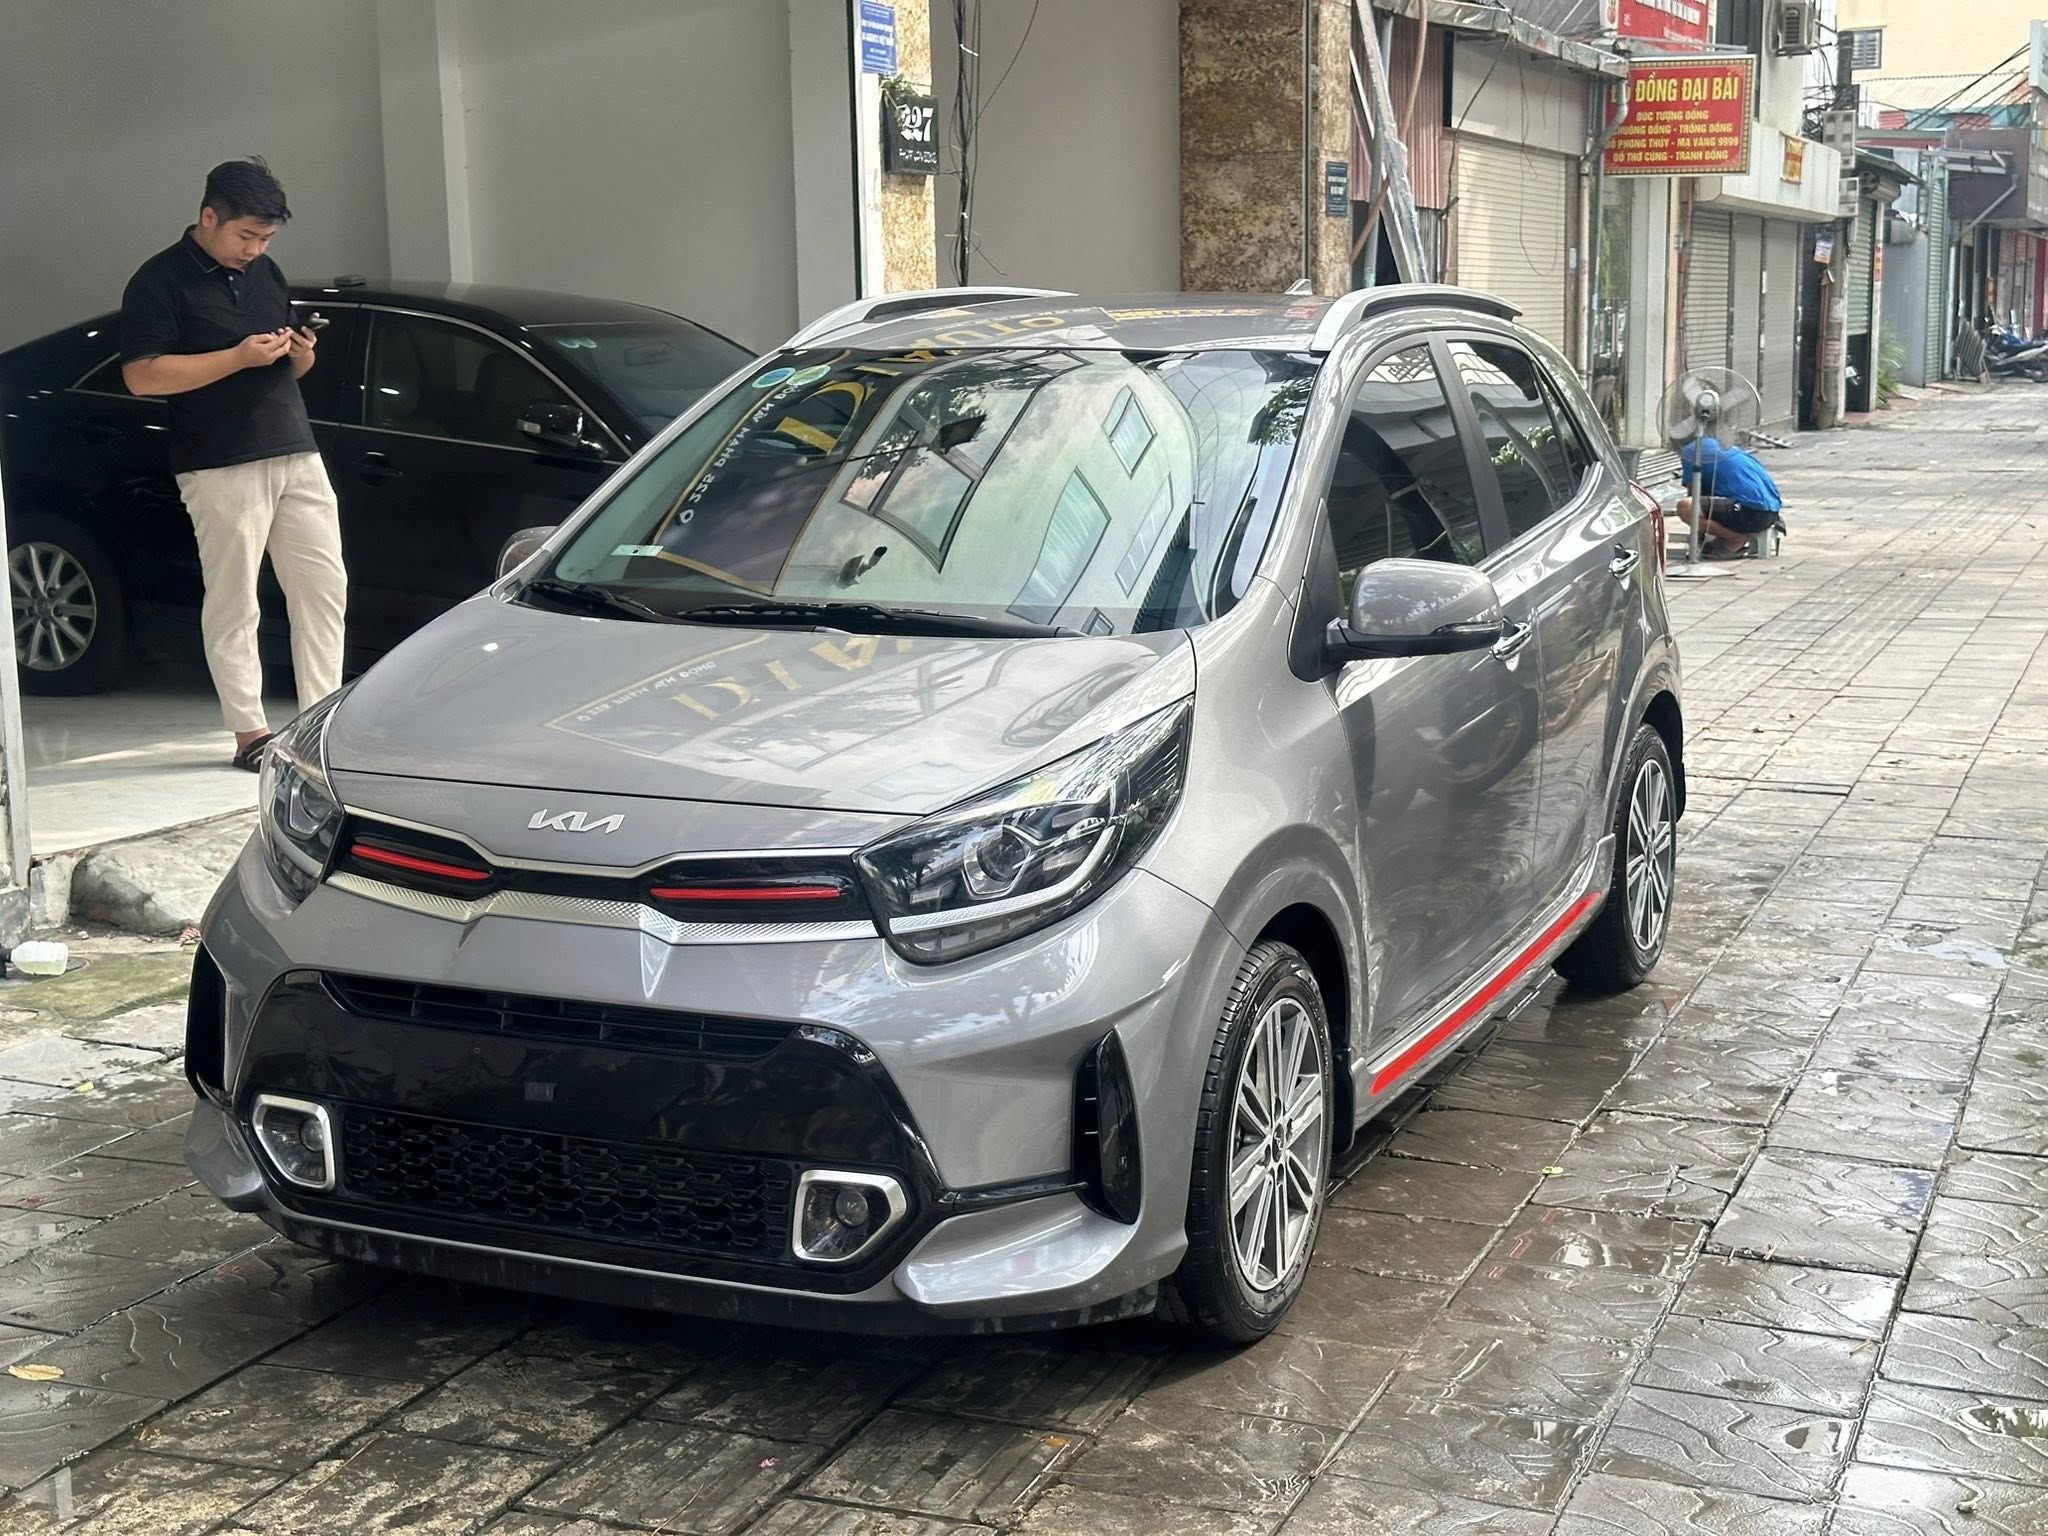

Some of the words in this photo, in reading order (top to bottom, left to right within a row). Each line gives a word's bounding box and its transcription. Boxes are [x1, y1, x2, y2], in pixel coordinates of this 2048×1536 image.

[1635, 71, 1677, 102] ĐỒNG
[1681, 77, 1708, 106] ĐẠI
[1712, 72, 1739, 100] BÁI
[528, 808, 625, 834] KIA
